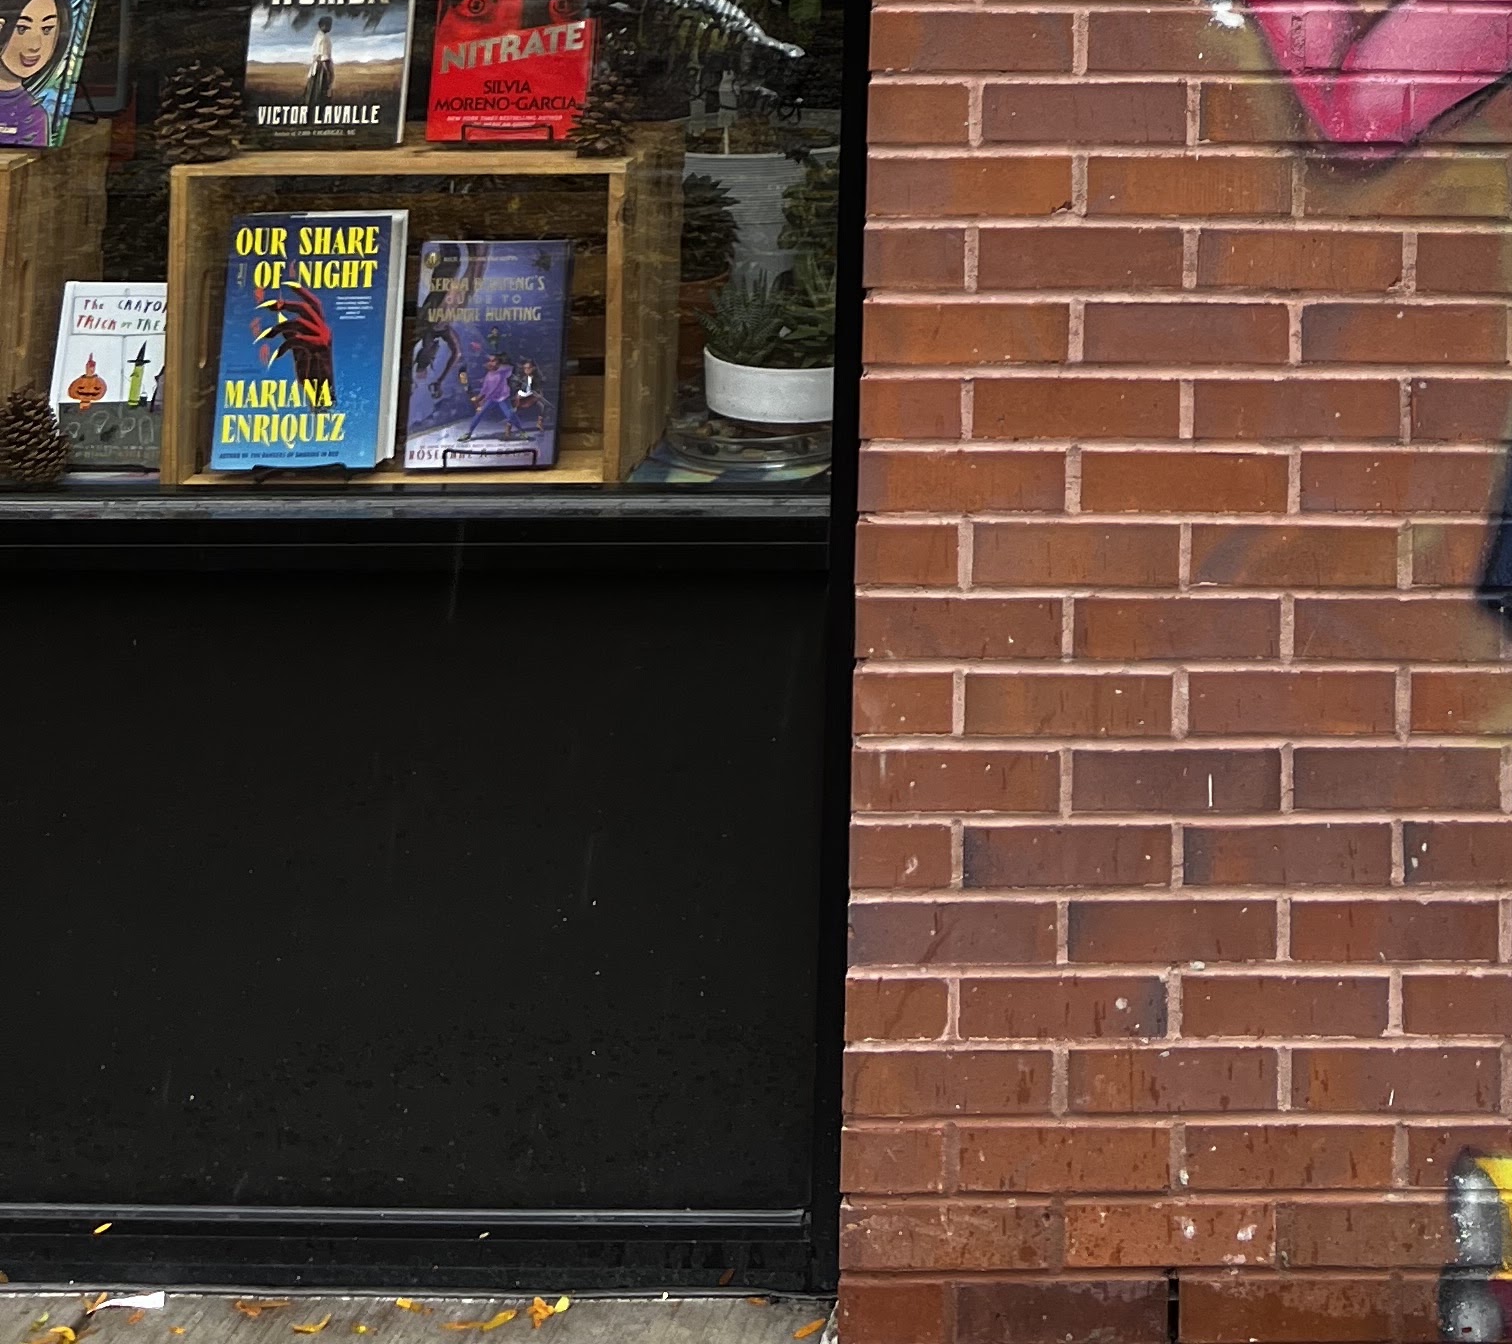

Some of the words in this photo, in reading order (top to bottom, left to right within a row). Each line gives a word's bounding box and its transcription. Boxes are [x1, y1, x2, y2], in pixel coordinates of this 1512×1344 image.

[439, 20, 586, 75] NITRATE
[483, 79, 532, 95] SILVIA
[257, 105, 308, 126] VICTOR
[314, 104, 381, 125] LAVALLE
[434, 96, 577, 113] MORENO-GARCIA
[235, 226, 288, 259] OUR
[299, 226, 380, 259] SHARE
[253, 261, 286, 290] OF
[298, 259, 378, 290] NIGHT
[136, 318, 167, 332] TRE
[223, 378, 334, 411] MARIANA
[221, 412, 346, 448] ENRIQUEZ
